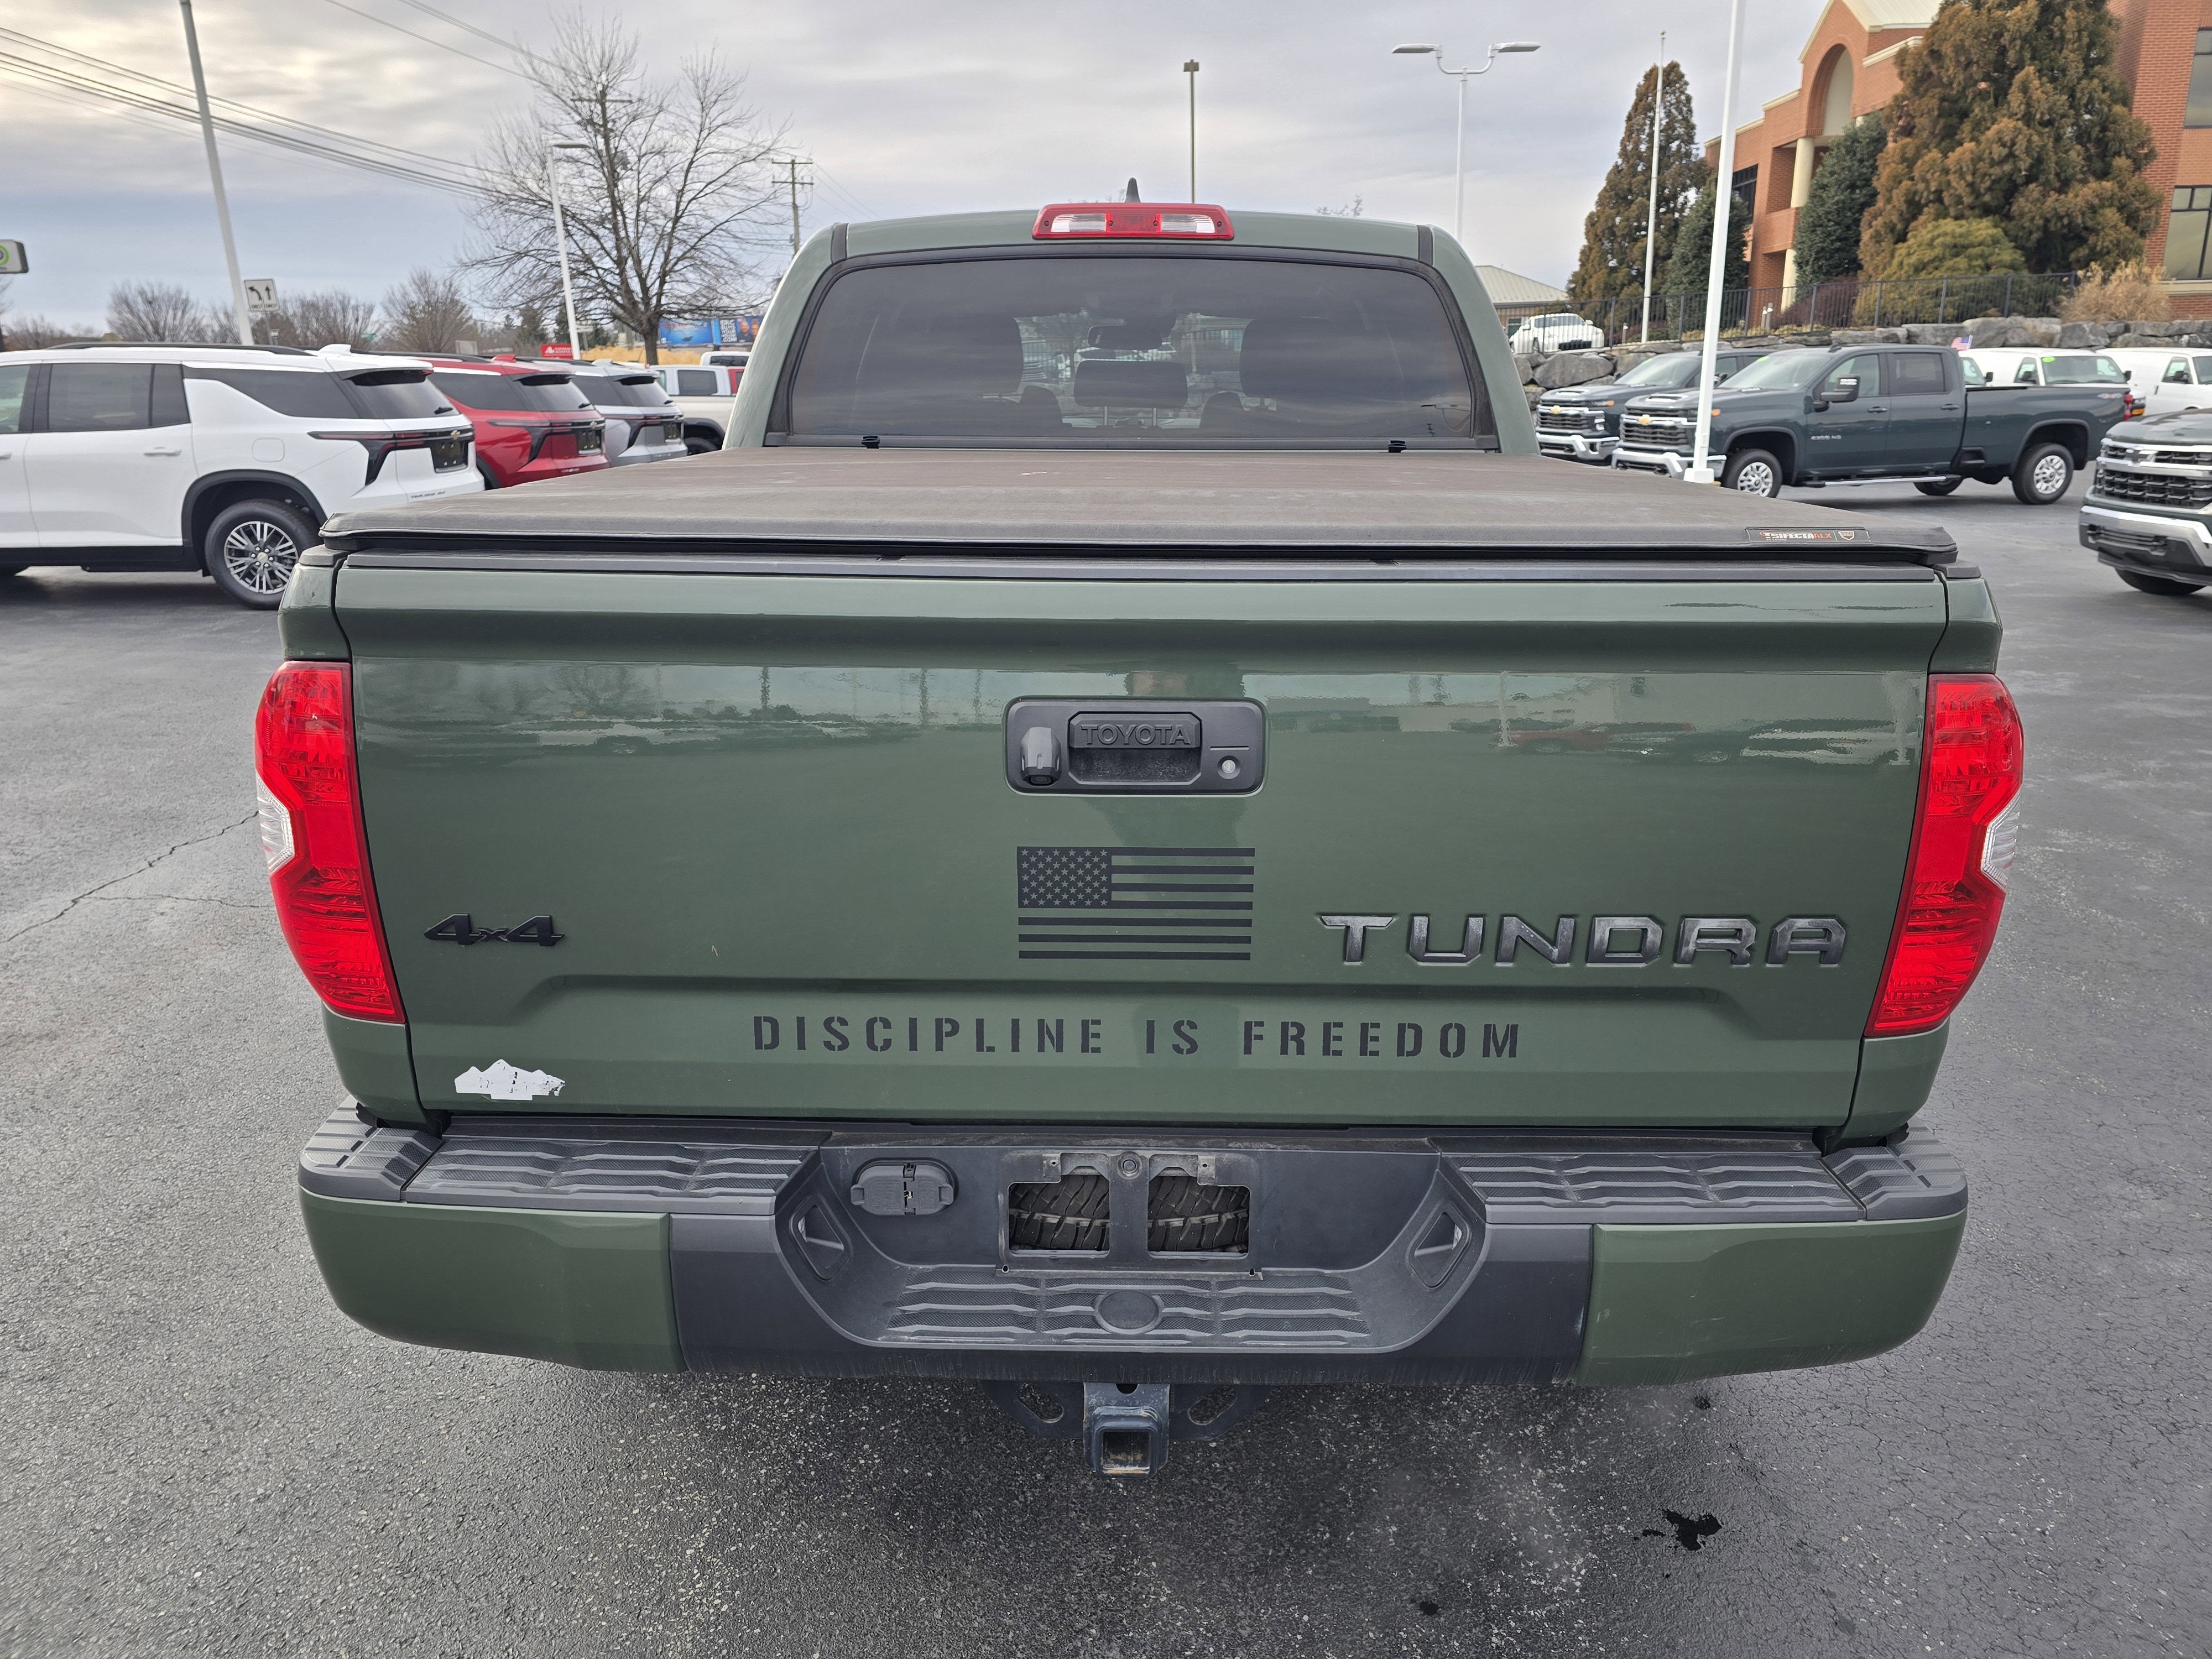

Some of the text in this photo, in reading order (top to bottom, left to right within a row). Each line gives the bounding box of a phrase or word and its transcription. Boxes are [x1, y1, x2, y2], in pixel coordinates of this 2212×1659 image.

[1081, 724, 1191, 745] TOYOTA
[1319, 915, 1847, 968] TUNDRA
[754, 1016, 1519, 1058] DISCIPLINE IS FREEDOM
